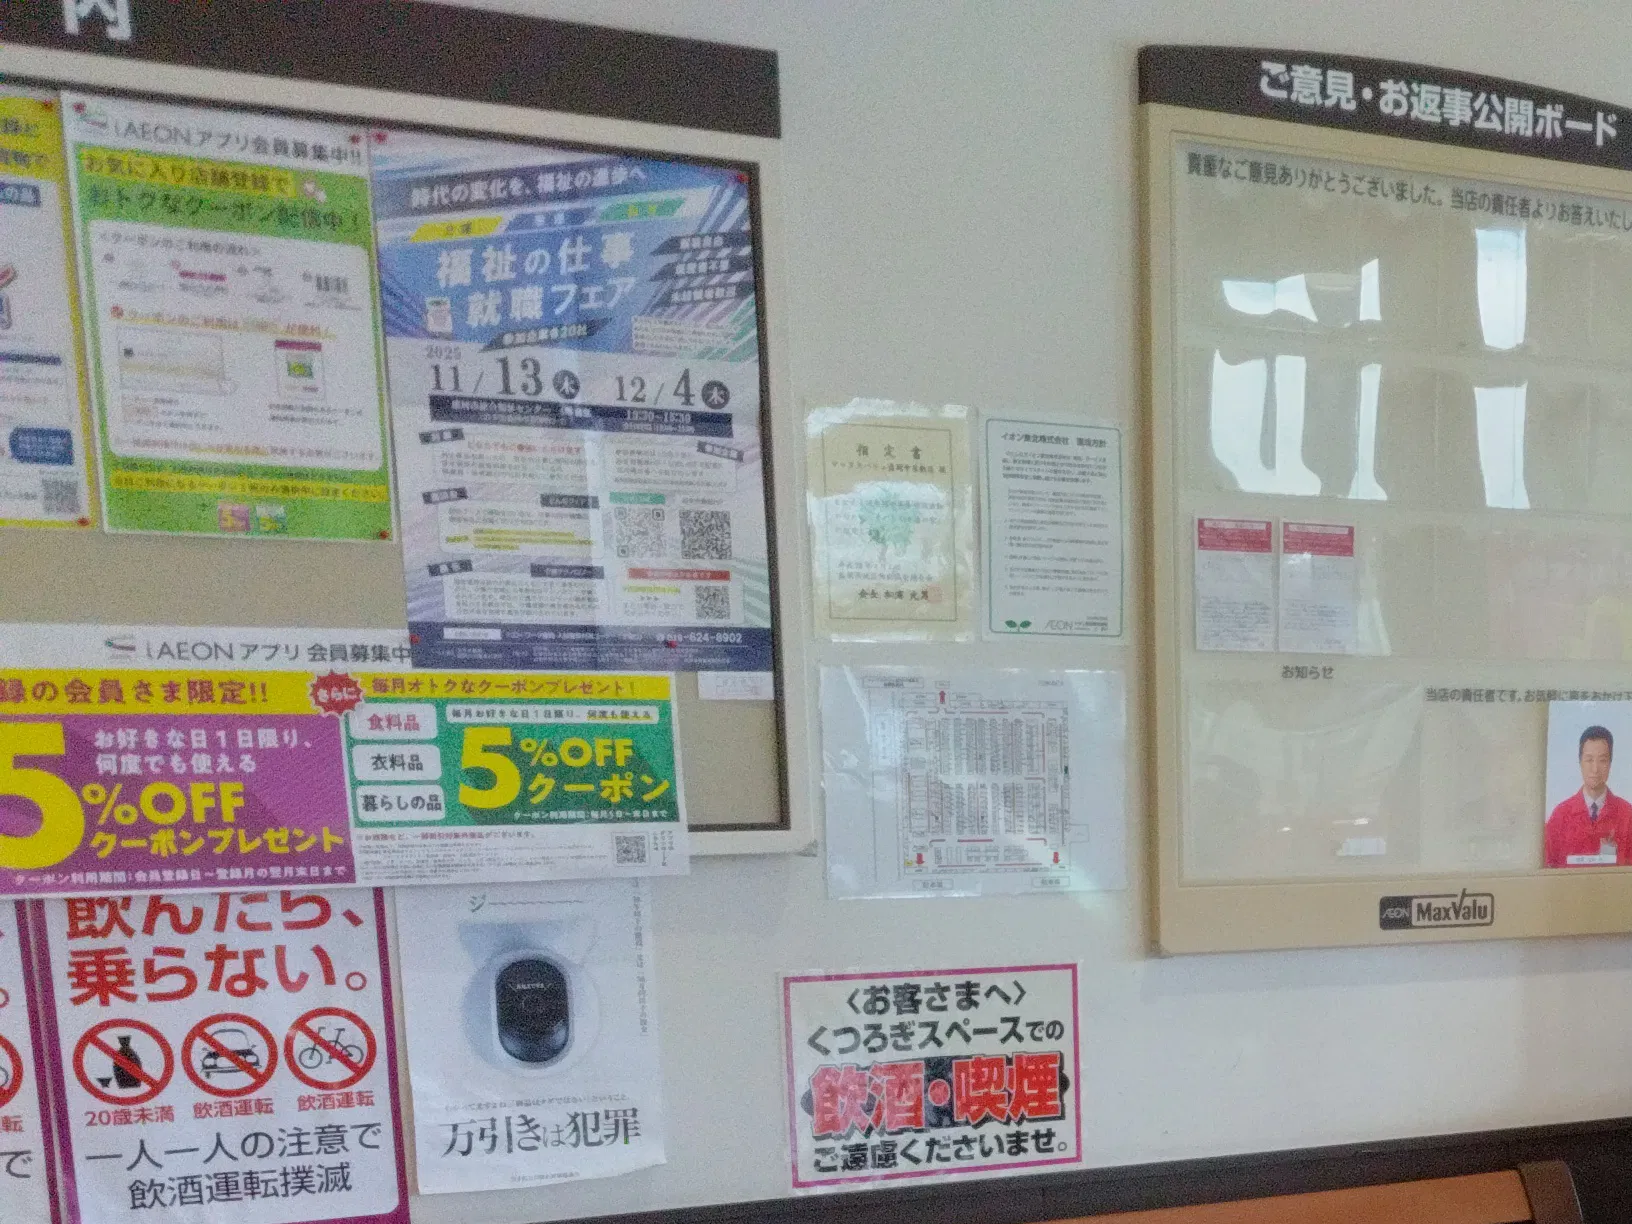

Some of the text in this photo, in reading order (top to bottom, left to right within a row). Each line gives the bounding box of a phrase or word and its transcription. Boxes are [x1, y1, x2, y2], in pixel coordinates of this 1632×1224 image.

[1260, 60, 1617, 146] ご意見・お返事公開ボード
[436, 232, 635, 288] 福祉の仕事
[465, 276, 637, 327] 就職フェア
[1281, 665, 1334, 679] お知らせ
[367, 713, 421, 732] 食料品
[95, 752, 258, 775] 何度でも使える
[371, 753, 423, 772] 衣料品
[361, 793, 442, 813] 暮らしの品
[529, 770, 670, 804] クーポン
[89, 826, 345, 858] クーポンプレゼント
[1415, 888, 1489, 923] MaxValu
[66, 944, 367, 1007] 乗らない。
[807, 1016, 1065, 1056] くつろぎスペースでの
[85, 1090, 375, 1128] 20歳未満 飲酒運転 飲酒運転
[811, 1052, 1062, 1138] 飲酒・喫煙
[85, 1121, 383, 1172] 一人一人の注意で
[441, 1107, 643, 1158] 万引きは犯罪
[813, 1128, 1068, 1173] ご遠慮くださいませ。
[129, 1161, 353, 1211] 飲酒運転撲滅
